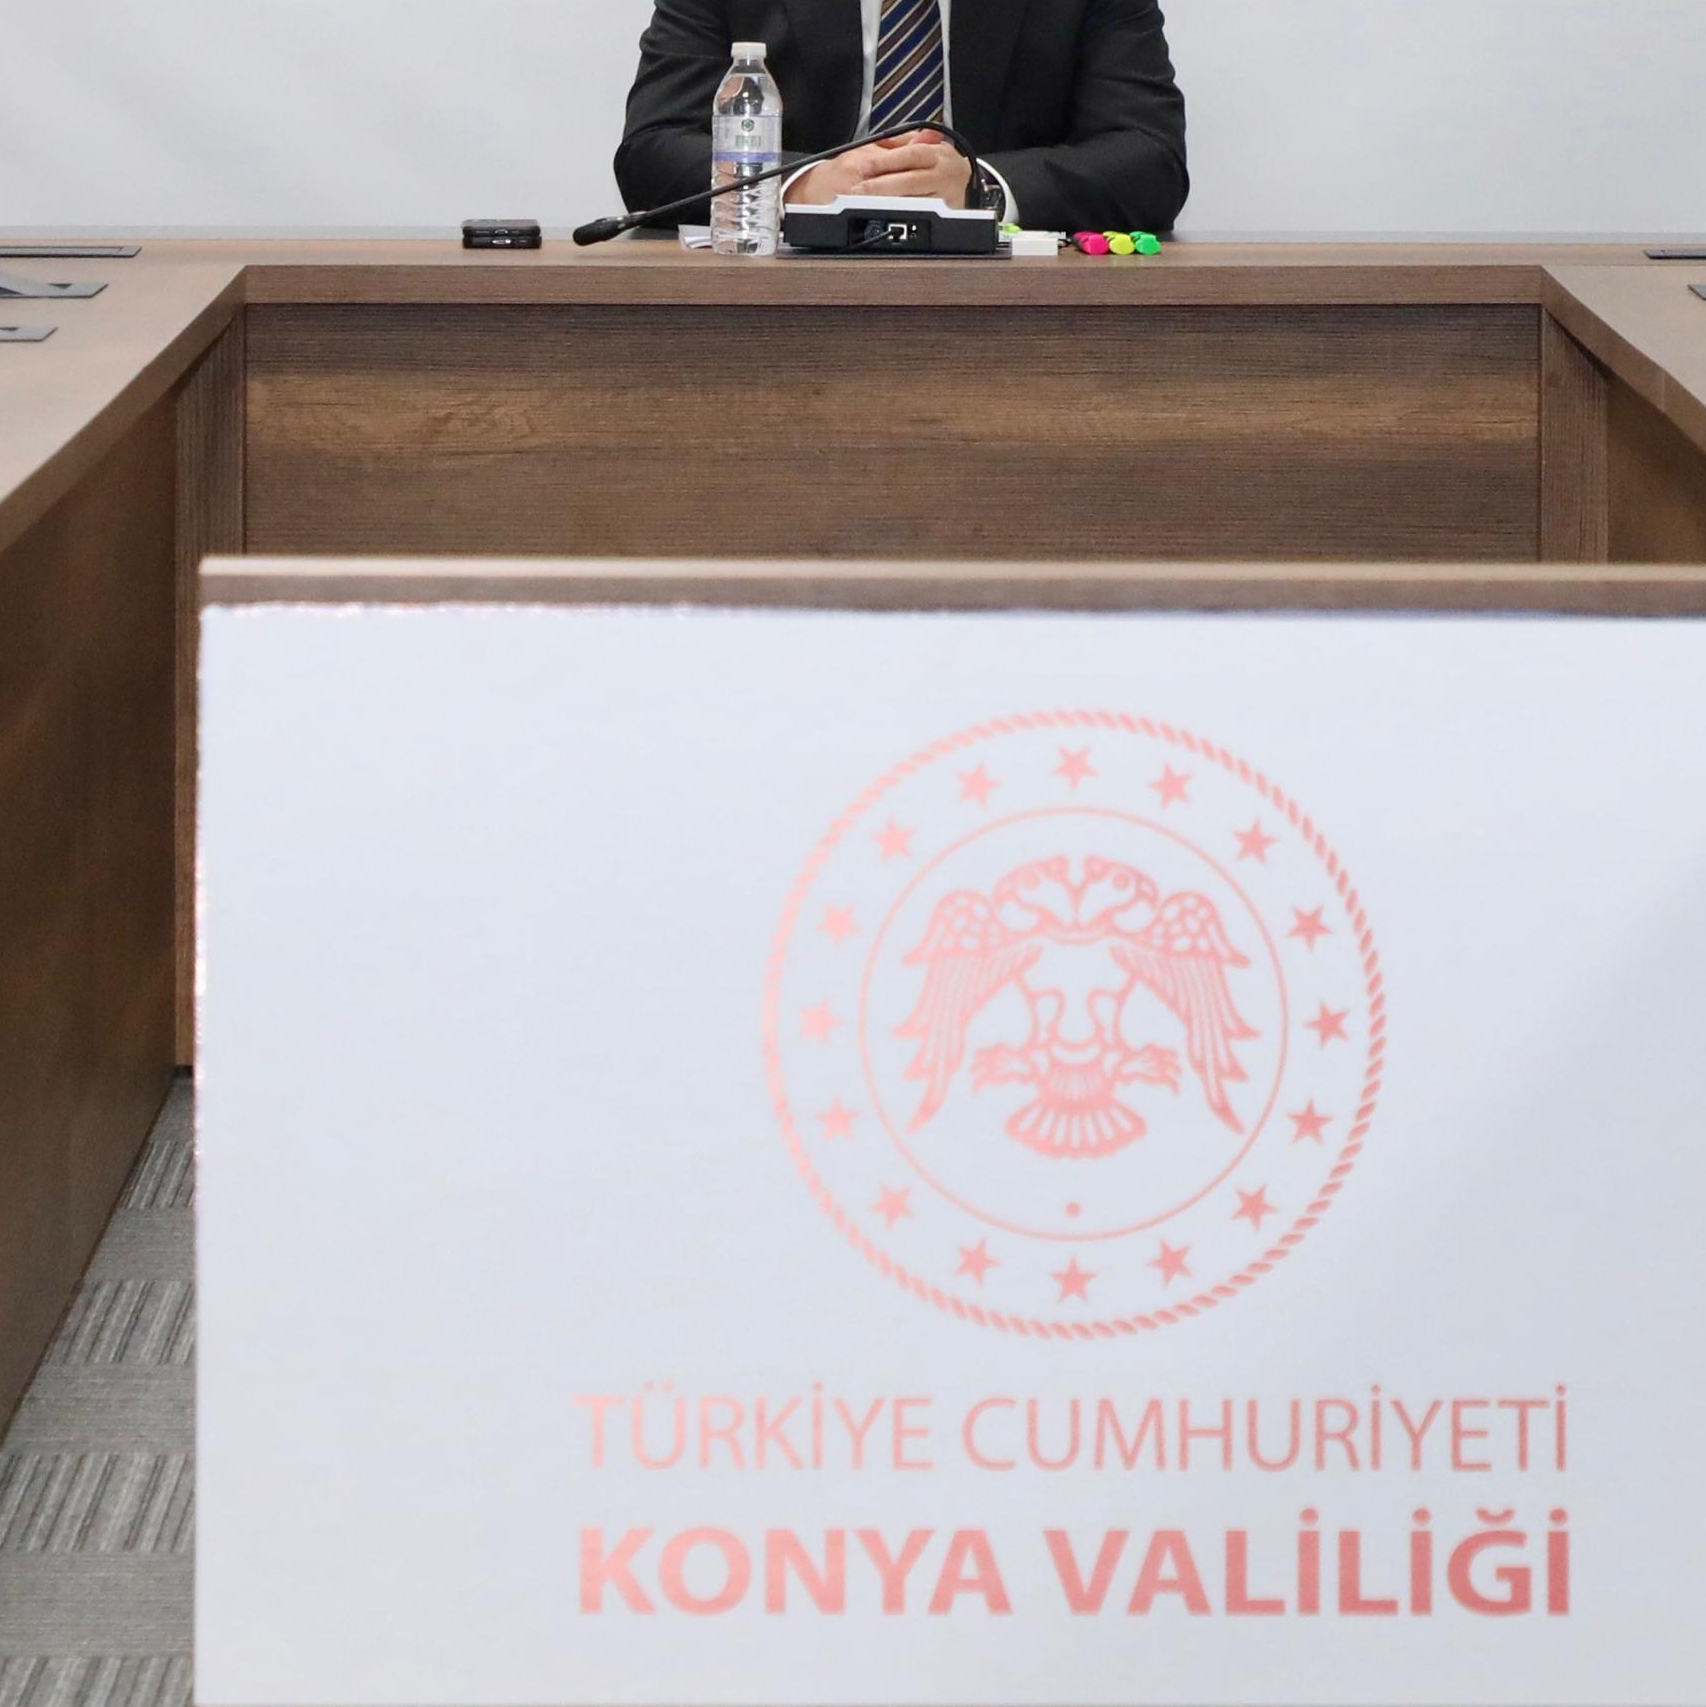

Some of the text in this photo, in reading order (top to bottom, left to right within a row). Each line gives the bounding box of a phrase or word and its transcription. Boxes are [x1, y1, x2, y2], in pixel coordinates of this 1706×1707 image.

[572, 1380, 1568, 1473] TÜRKİYE CUMHURİYETİ
[579, 1505, 1571, 1617] KONYA VALİLİĞİ
